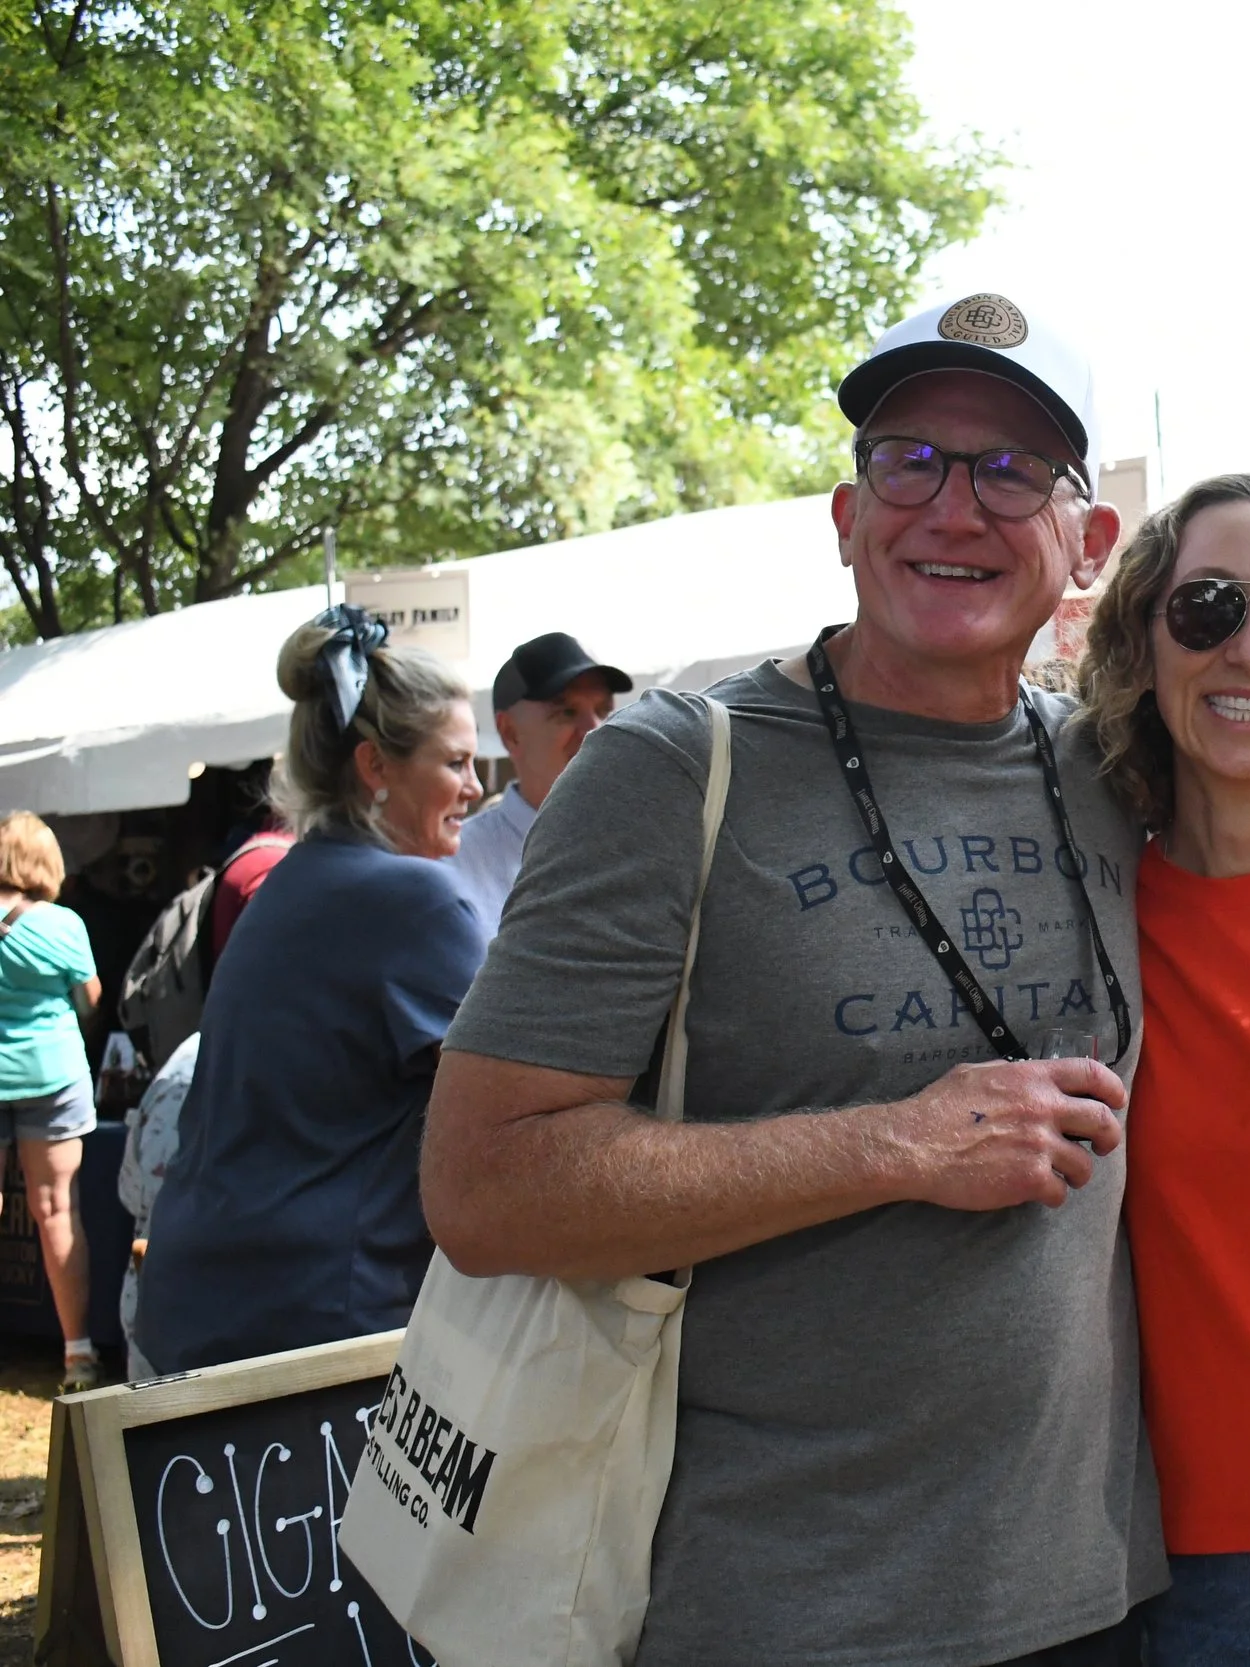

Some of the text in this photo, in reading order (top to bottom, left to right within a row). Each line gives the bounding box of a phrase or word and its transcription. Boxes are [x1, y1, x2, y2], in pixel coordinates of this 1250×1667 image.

[953, 331, 1001, 344] GUILD
[787, 835, 1124, 912] BOURBON
[407, 1403, 498, 1536] BEAM
[410, 1494, 429, 1529] CO.
